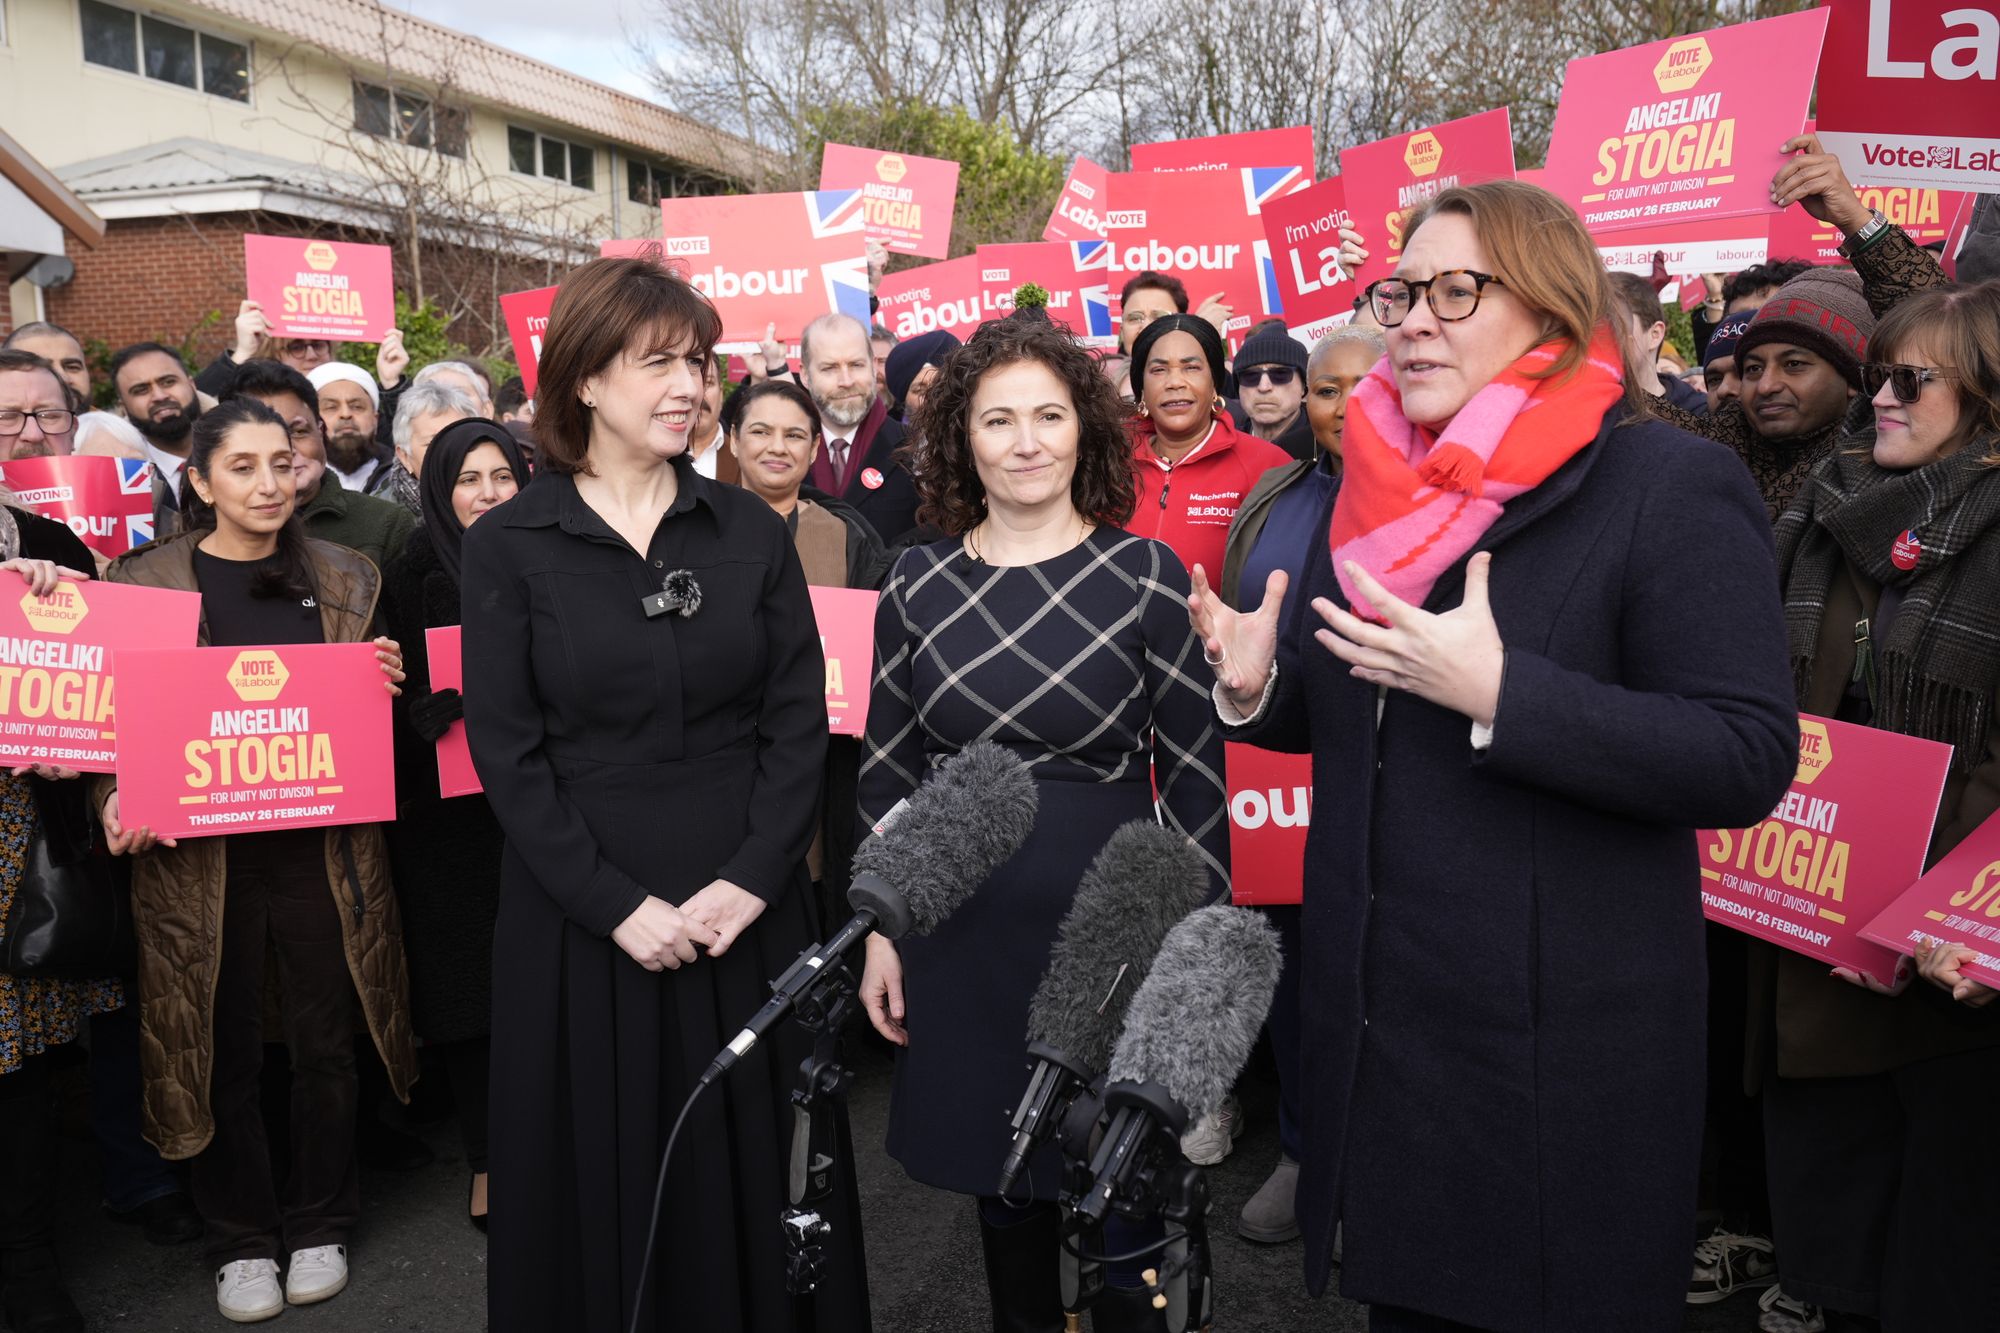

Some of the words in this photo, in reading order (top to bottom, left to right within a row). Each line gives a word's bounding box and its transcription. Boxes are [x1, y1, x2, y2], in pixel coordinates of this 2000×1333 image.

[1669, 47, 1701, 67] VOTE
[1668, 65, 1703, 79] Labour
[1624, 92, 1722, 133] ANGELIKI
[1412, 140, 1433, 156] VOTE
[1592, 118, 1735, 186] STOGIA
[1862, 144, 1925, 167] Vote
[863, 182, 912, 202] ANGELIKI
[1608, 188, 1623, 201] FOR
[1625, 184, 1650, 200] UNITY
[1651, 182, 1668, 195] NOT
[1670, 177, 1705, 193] DIVISON
[1109, 214, 1144, 224] VOTE
[1584, 208, 1643, 224] THURSDAY
[1644, 205, 1657, 216] 26
[1659, 197, 1722, 214] FEBRUARY
[1285, 224, 1309, 244] I'm
[670, 240, 707, 252] VOTE
[1107, 240, 1240, 272] Labour
[296, 272, 348, 289] ANGELIKI
[686, 266, 808, 298] abour
[984, 271, 1008, 280] VOTE
[283, 286, 364, 317] STOGIA
[894, 288, 931, 304] voting
[1229, 318, 1248, 327] VOTE
[24, 489, 70, 501] VOTING
[1190, 492, 1240, 501] Manchester
[1199, 506, 1238, 517] Labour
[39, 608, 78, 620] Labour
[241, 660, 275, 676] VOTE
[245, 678, 281, 687] Labour
[5, 722, 35, 735] UNITY
[37, 725, 57, 737] NOT
[60, 726, 98, 740] DIVISON
[210, 707, 309, 737] ANGELIKI
[32, 746, 48, 757] 26
[50, 748, 116, 762] FEBRUARY
[184, 733, 336, 788] STOGIA
[211, 792, 228, 804] FOR
[231, 790, 257, 803] UNITY
[260, 788, 278, 800] NOT
[280, 786, 314, 799] DIVISON
[189, 811, 256, 826] THURSDAY
[258, 809, 272, 820] 26
[274, 805, 335, 819] FEBRUARY
[1722, 873, 1739, 890] FOR
[1739, 879, 1763, 897] UNITY
[1764, 886, 1781, 902] NOT
[1782, 892, 1817, 917] DIVISON
[1701, 891, 1756, 921] THURSDAY
[1756, 911, 1770, 927] 26
[1771, 916, 1831, 948] FEBRUARY
